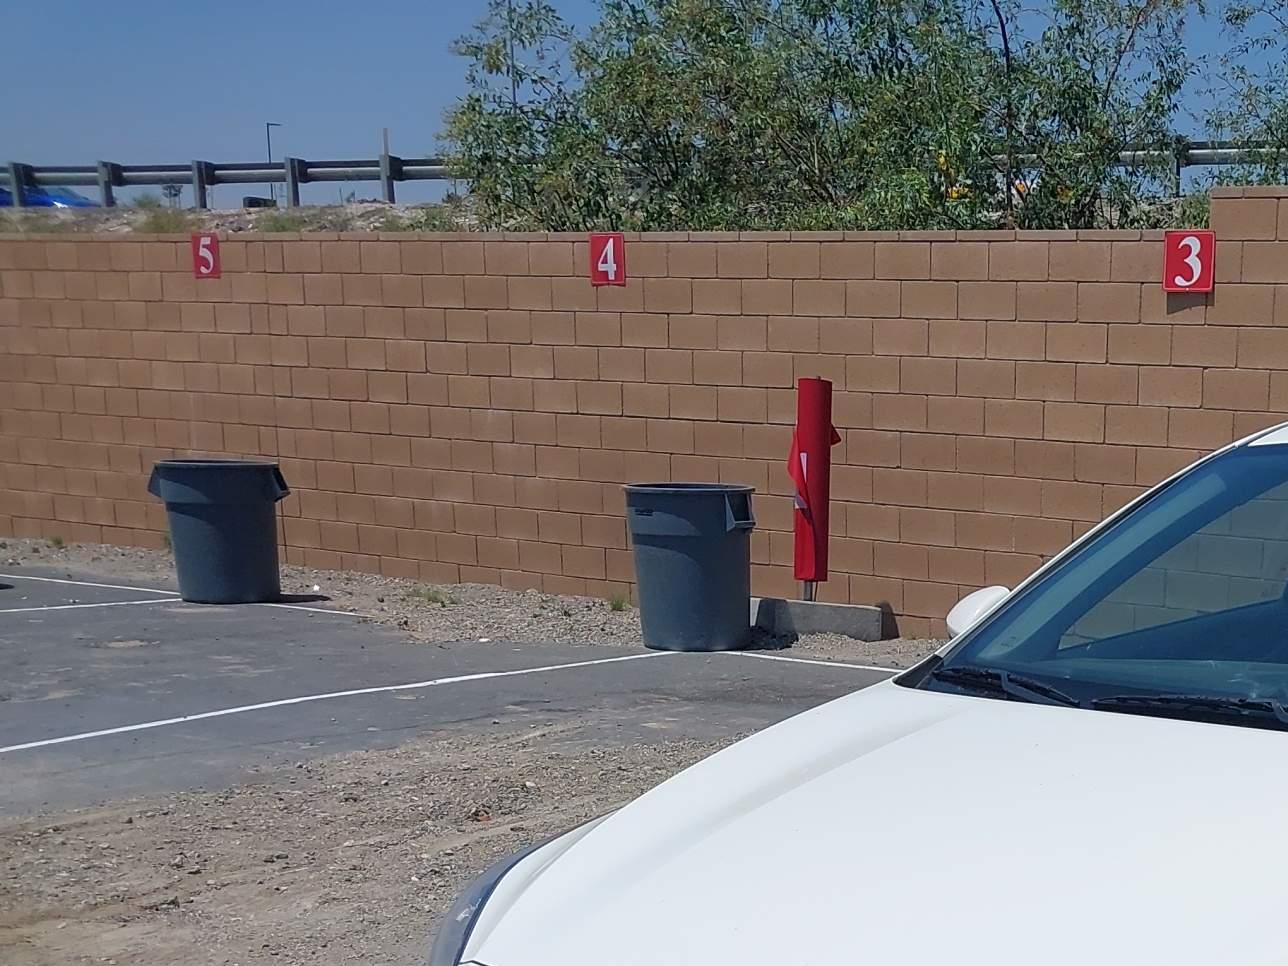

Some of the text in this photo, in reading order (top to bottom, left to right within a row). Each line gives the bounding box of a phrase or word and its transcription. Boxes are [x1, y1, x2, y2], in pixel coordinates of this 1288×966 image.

[198, 236, 214, 274] 5
[597, 237, 617, 281] 4
[1174, 235, 1202, 287] 3
